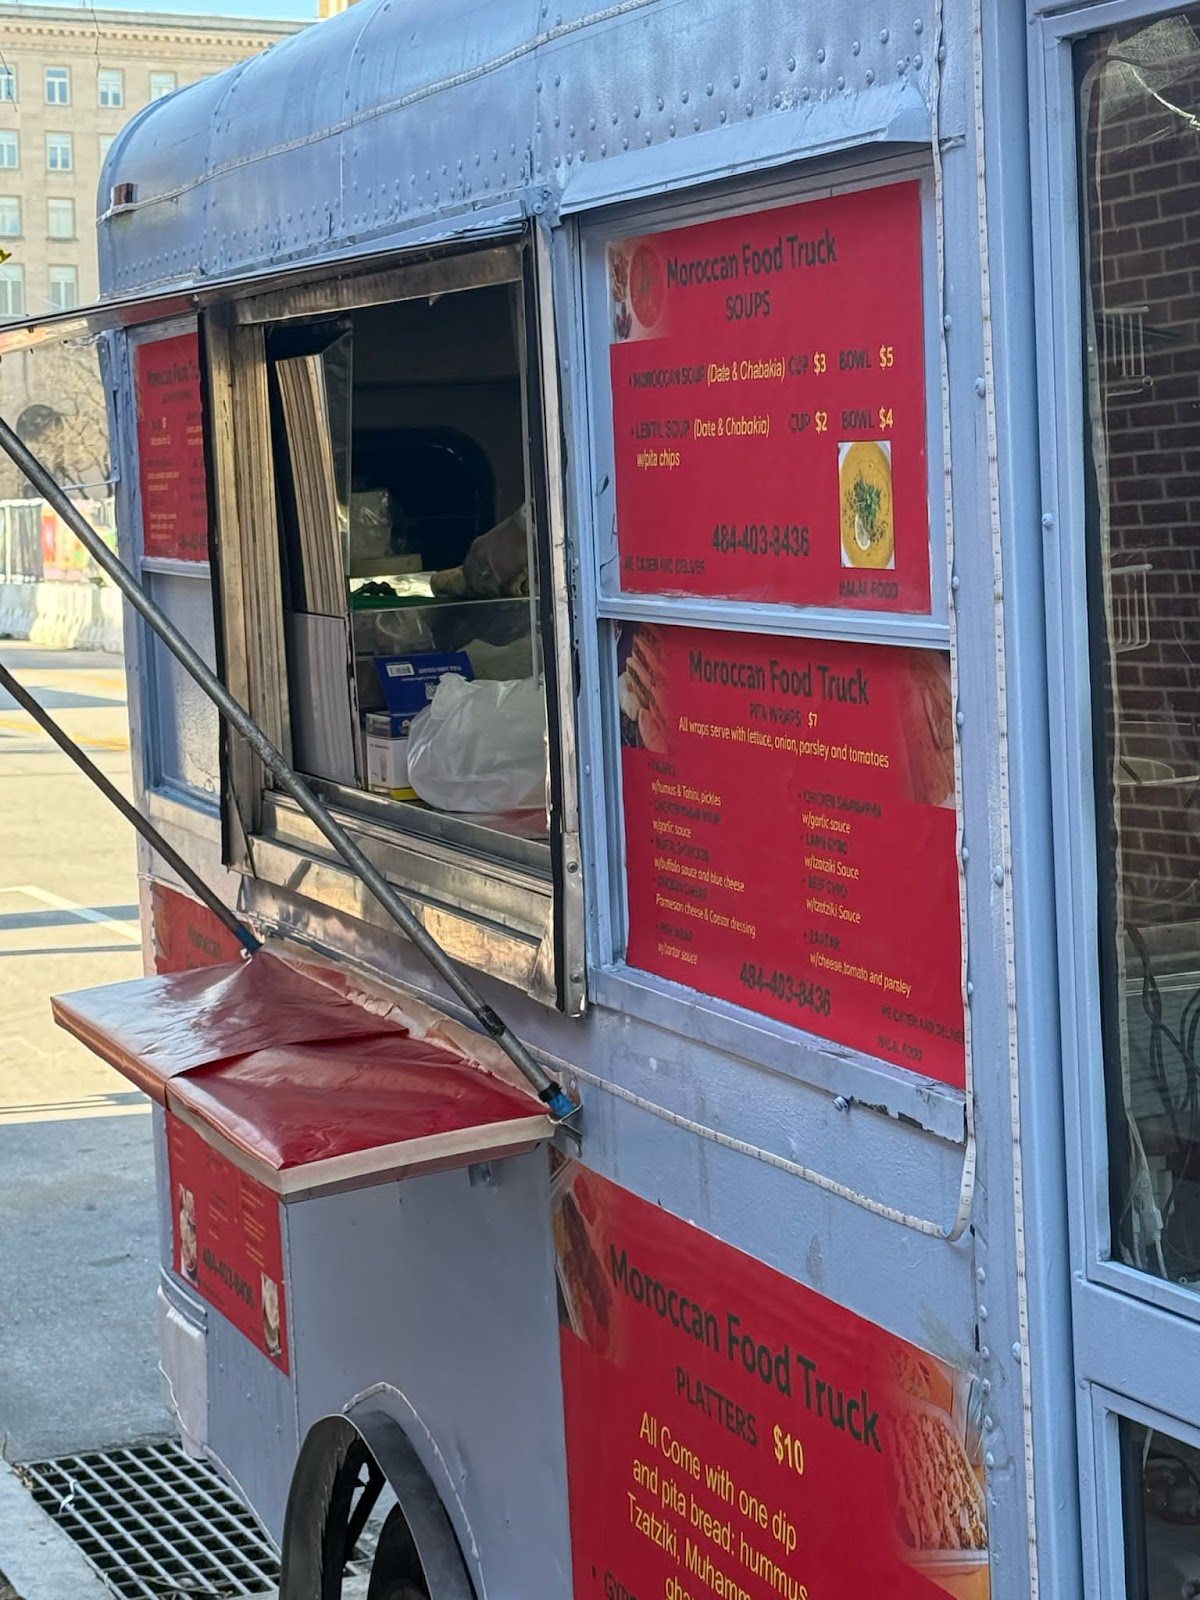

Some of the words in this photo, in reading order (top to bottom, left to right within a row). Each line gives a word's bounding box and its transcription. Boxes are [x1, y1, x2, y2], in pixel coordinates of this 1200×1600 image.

[667, 253, 739, 288] Moroccan
[742, 237, 783, 276] Food
[787, 226, 838, 266] Truck
[726, 290, 771, 321] SOUPS
[707, 363, 730, 386] (Date
[732, 362, 739, 382] &
[740, 357, 786, 382] Chabakia)
[813, 351, 827, 375] $3
[839, 349, 872, 371] BOWL
[879, 345, 894, 371] $5
[694, 417, 716, 440] (Date
[718, 417, 724, 436] &
[725, 414, 770, 438] Chabakia)
[815, 411, 828, 435] $2
[842, 409, 874, 430] BOWL
[879, 406, 894, 431] $4
[659, 448, 680, 470] chips
[713, 524, 810, 557] 484-403-8436
[689, 650, 765, 691] Moroccan
[770, 659, 812, 698] Food
[817, 663, 869, 705] Truck
[808, 712, 818, 728] $7
[679, 715, 688, 732] All
[689, 721, 709, 738] wraps
[710, 725, 730, 740] serve
[731, 725, 746, 743] with
[747, 727, 774, 751] lettuce,
[774, 735, 798, 757] onion,
[799, 739, 829, 762] parsley
[830, 744, 847, 761] and
[849, 746, 889, 769] tomatoes
[701, 790, 721, 806] pickles
[675, 826, 692, 838] sauce
[801, 811, 829, 830] w/garlic
[830, 819, 851, 835] sauce
[681, 864, 698, 878] sauce
[698, 868, 710, 881] and
[710, 871, 723, 886] blue
[724, 875, 745, 893] cheese
[804, 854, 836, 874] w/tzatziki
[837, 861, 860, 881] Sauce
[684, 902, 704, 920] cheese
[704, 908, 709, 921] &
[709, 910, 730, 928] Caesar
[730, 917, 756, 939] dressing
[806, 897, 837, 917] w/tzatziki
[838, 904, 862, 924] Sauce
[681, 950, 698, 965] sauce
[740, 961, 832, 1018] 484-403-8436
[869, 971, 883, 986] and
[884, 976, 911, 999] parsley
[609, 1243, 719, 1352] Moroccan
[728, 1311, 791, 1397] Food
[798, 1353, 882, 1452] Truck
[676, 1366, 758, 1447] PLATTERS
[773, 1424, 804, 1476] $10
[639, 1411, 657, 1448] All
[660, 1425, 701, 1481] Come
[705, 1461, 736, 1504] with
[739, 1489, 768, 1531] one
[772, 1511, 797, 1555] dip
[627, 1491, 680, 1565] Tzatziki,
[632, 1457, 658, 1497] and
[661, 1478, 686, 1518] pita
[690, 1494, 736, 1554] bread:
[740, 1532, 808, 1600] hummus
